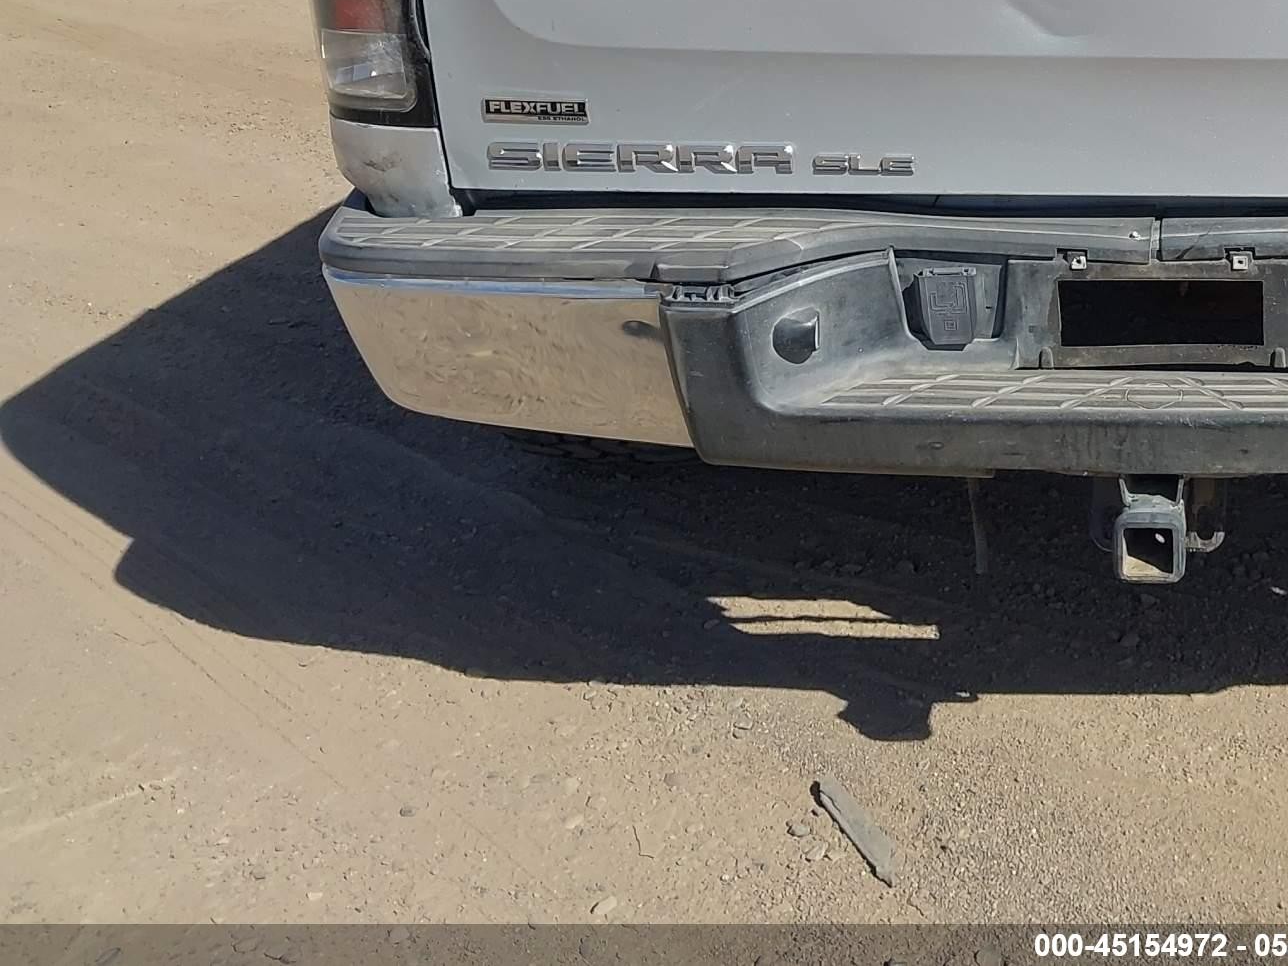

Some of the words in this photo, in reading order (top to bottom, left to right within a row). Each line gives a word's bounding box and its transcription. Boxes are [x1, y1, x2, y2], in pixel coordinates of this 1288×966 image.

[489, 100, 585, 115] FLEXFUEL
[487, 141, 794, 175] SIERRA
[812, 152, 916, 177] SLE
